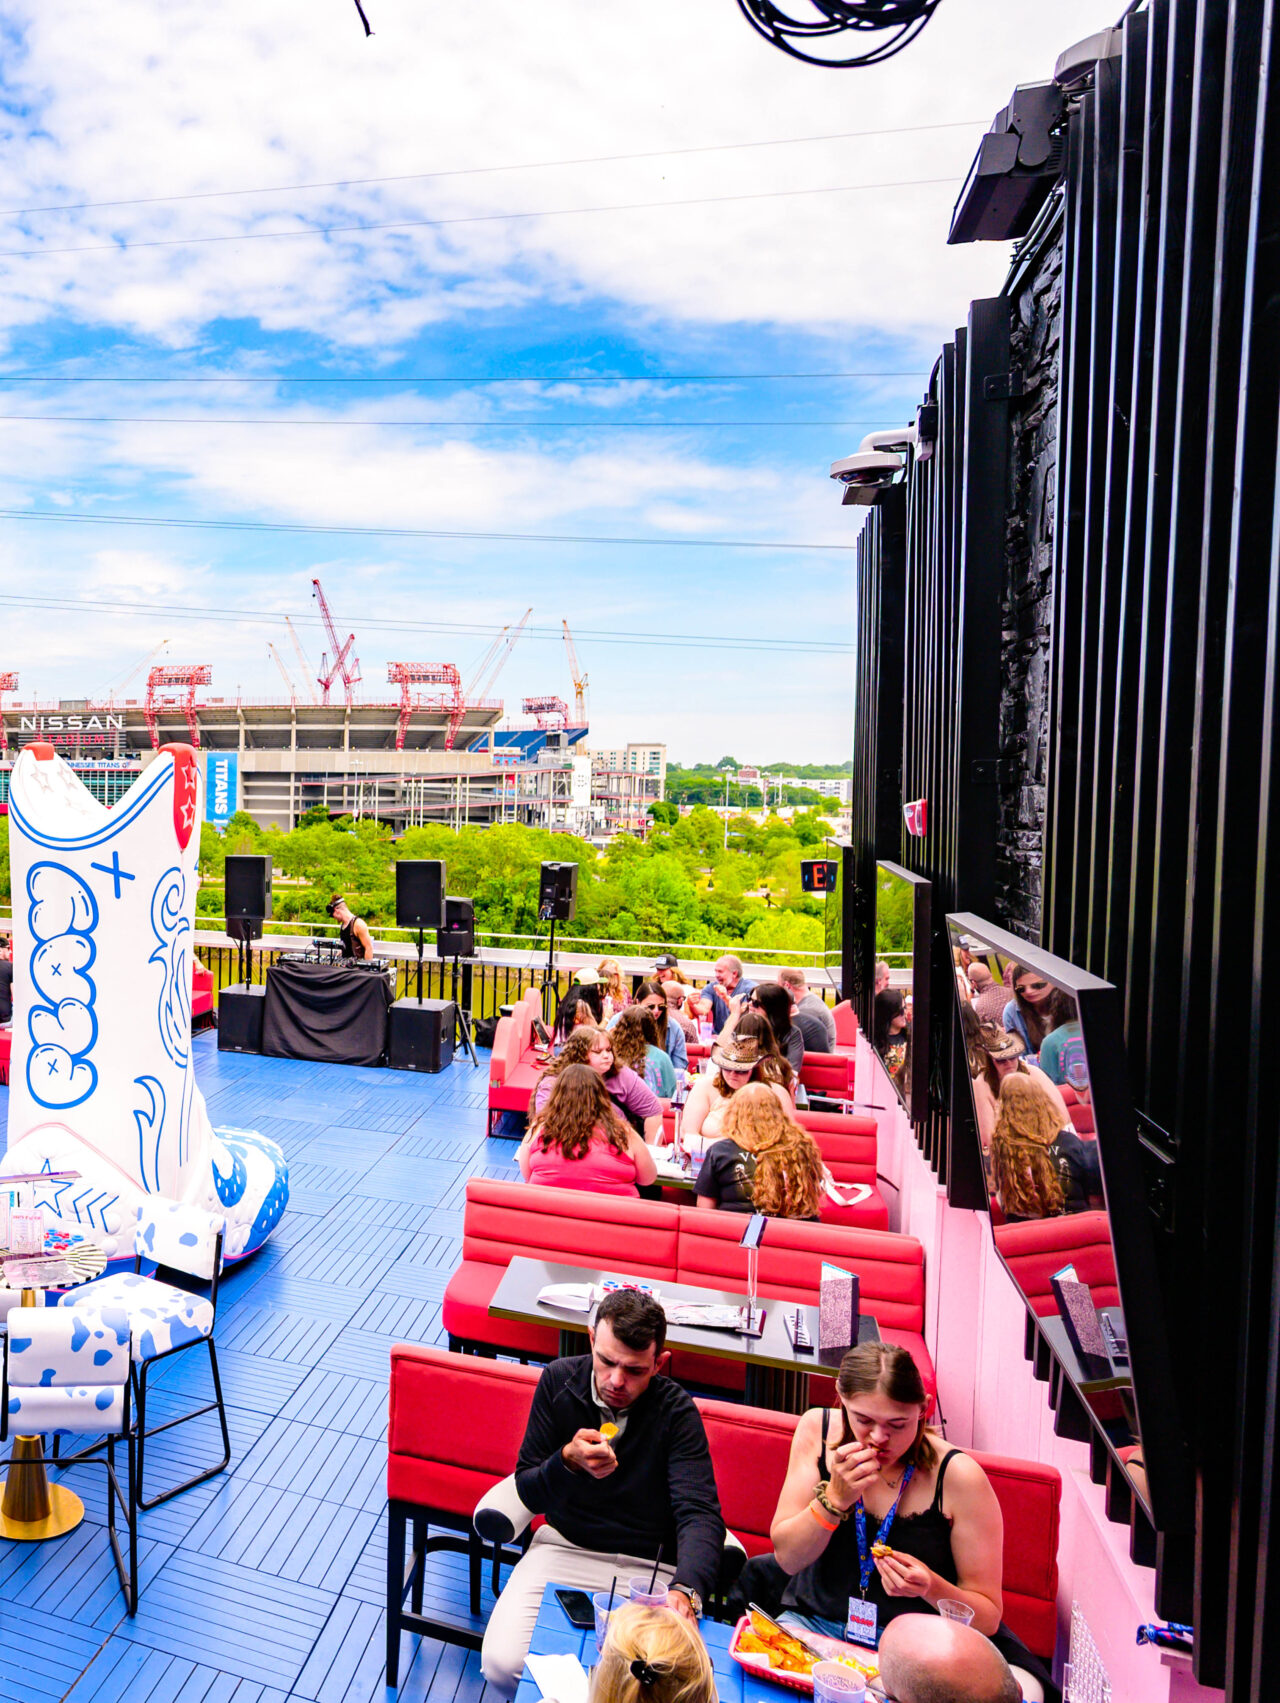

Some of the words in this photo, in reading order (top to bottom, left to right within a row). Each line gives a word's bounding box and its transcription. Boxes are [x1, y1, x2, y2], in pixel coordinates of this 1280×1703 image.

[20, 715, 123, 731] NISSAN
[36, 733, 106, 745] STADIUM
[97, 761, 120, 769] TITANS
[214, 759, 228, 815] TITANS
[812, 863, 827, 888] E
